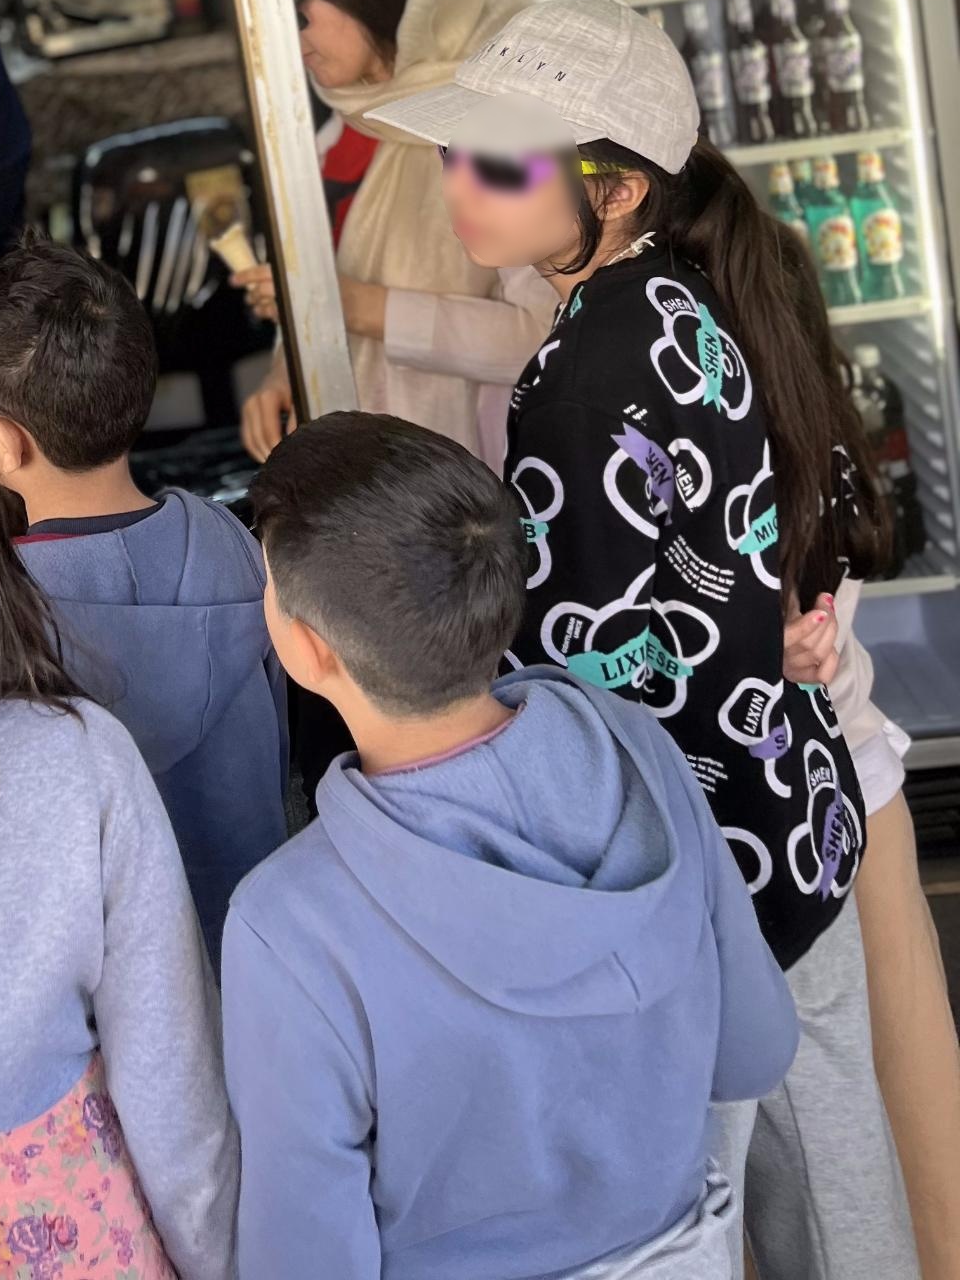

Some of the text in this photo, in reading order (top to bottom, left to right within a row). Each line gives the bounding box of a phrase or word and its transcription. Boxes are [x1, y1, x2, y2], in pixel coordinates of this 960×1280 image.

[662, 297, 693, 313] SHEN
[704, 331, 719, 379] SHEN
[742, 692, 767, 735] LIXIN
[809, 766, 832, 788] SHEN
